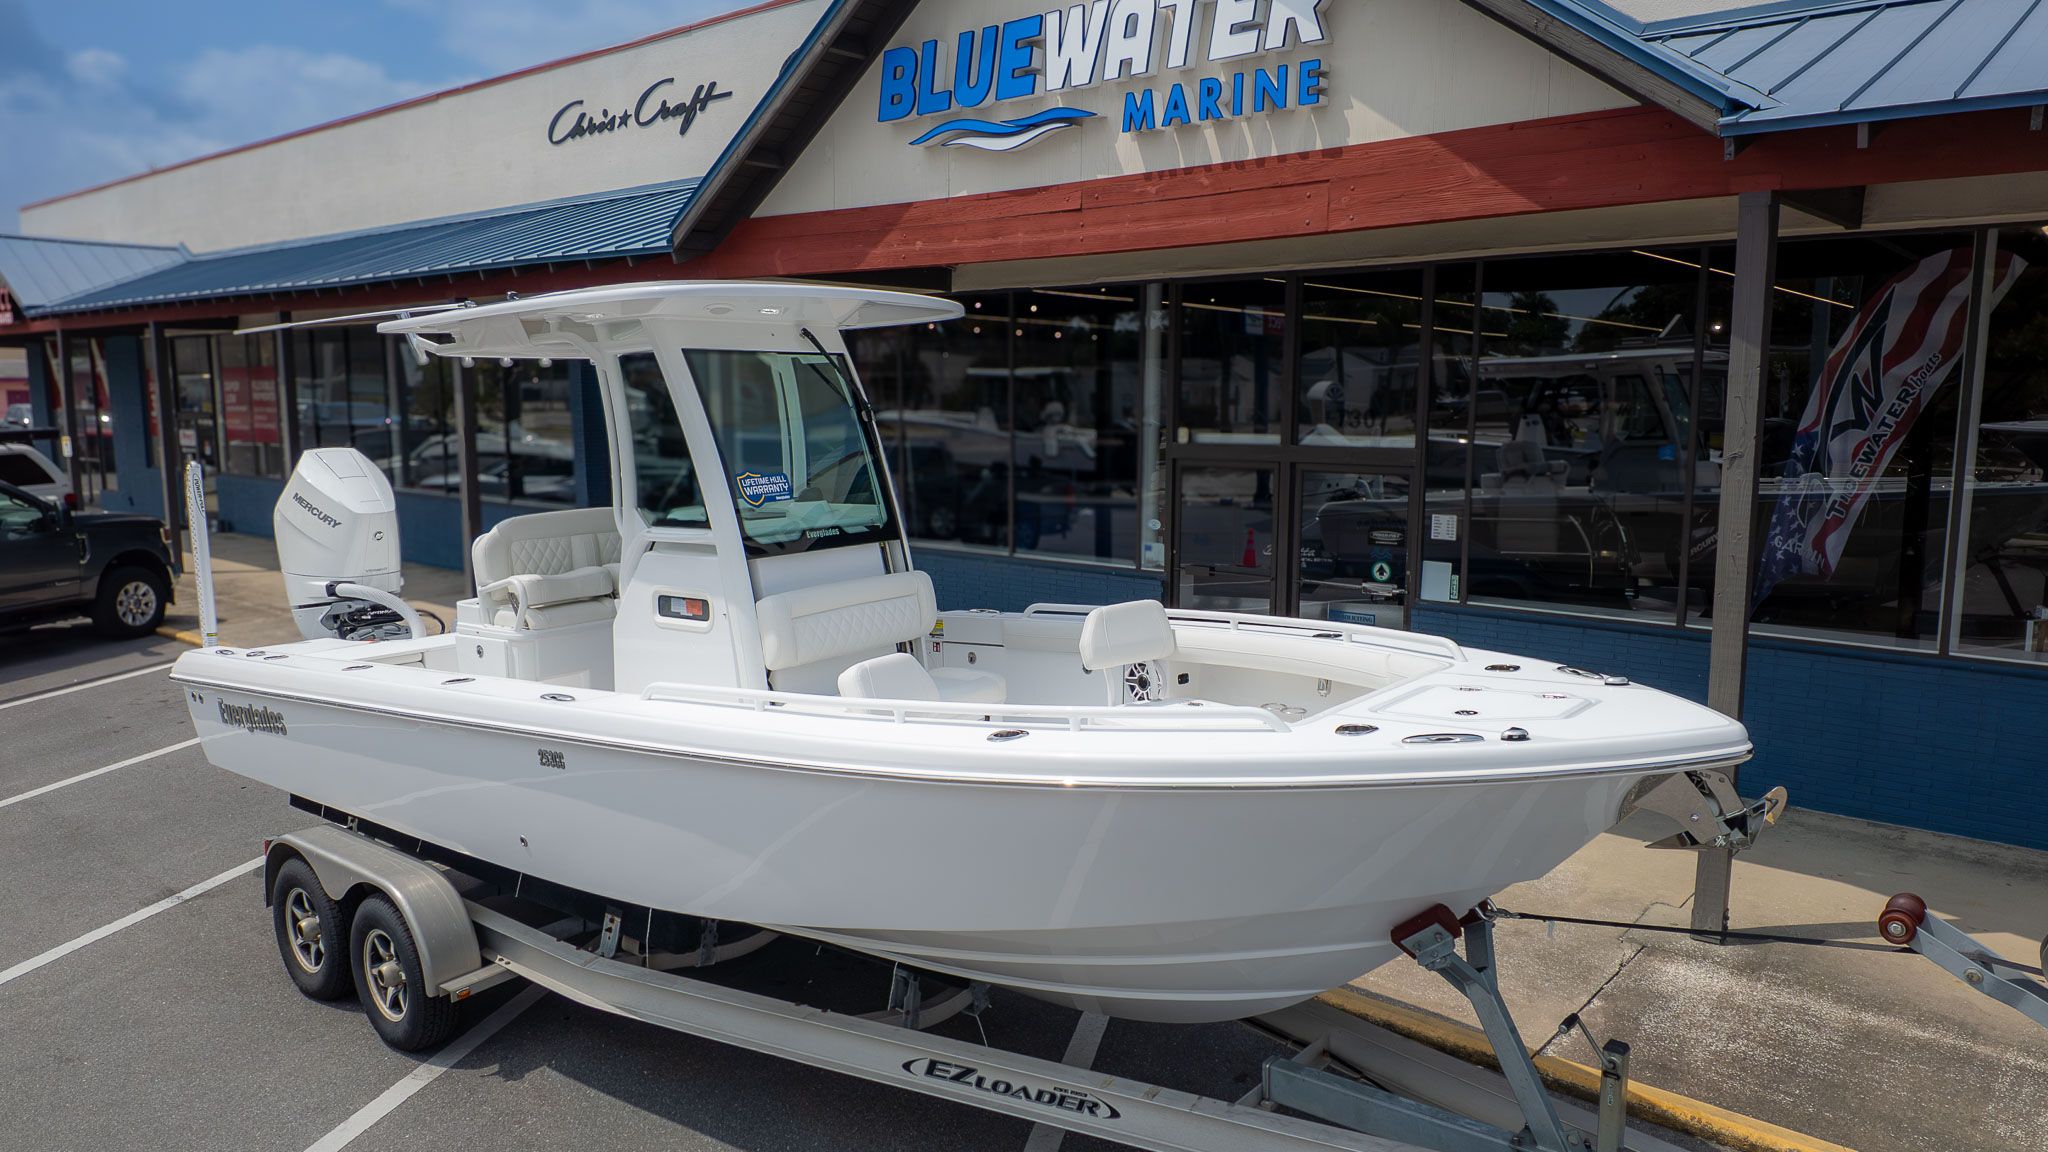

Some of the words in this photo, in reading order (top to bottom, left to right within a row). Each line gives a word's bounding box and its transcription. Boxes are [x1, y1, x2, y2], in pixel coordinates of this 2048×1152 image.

[878, 0, 1326, 123] BLUEWATER
[548, 100, 616, 145] Chris
[634, 77, 732, 136] Craft
[1122, 59, 1322, 133] MARINE
[1825, 386, 1918, 520] TIDEWATER
[1909, 352, 1942, 391] boats
[742, 477, 769, 487] LIFETIME
[770, 475, 787, 483] HULL
[744, 483, 789, 496] WARRANTY
[293, 492, 342, 529] MERCURY
[806, 528, 840, 539] Everglades
[1774, 535, 1825, 568] GARIN
[217, 697, 288, 736] Everglades
